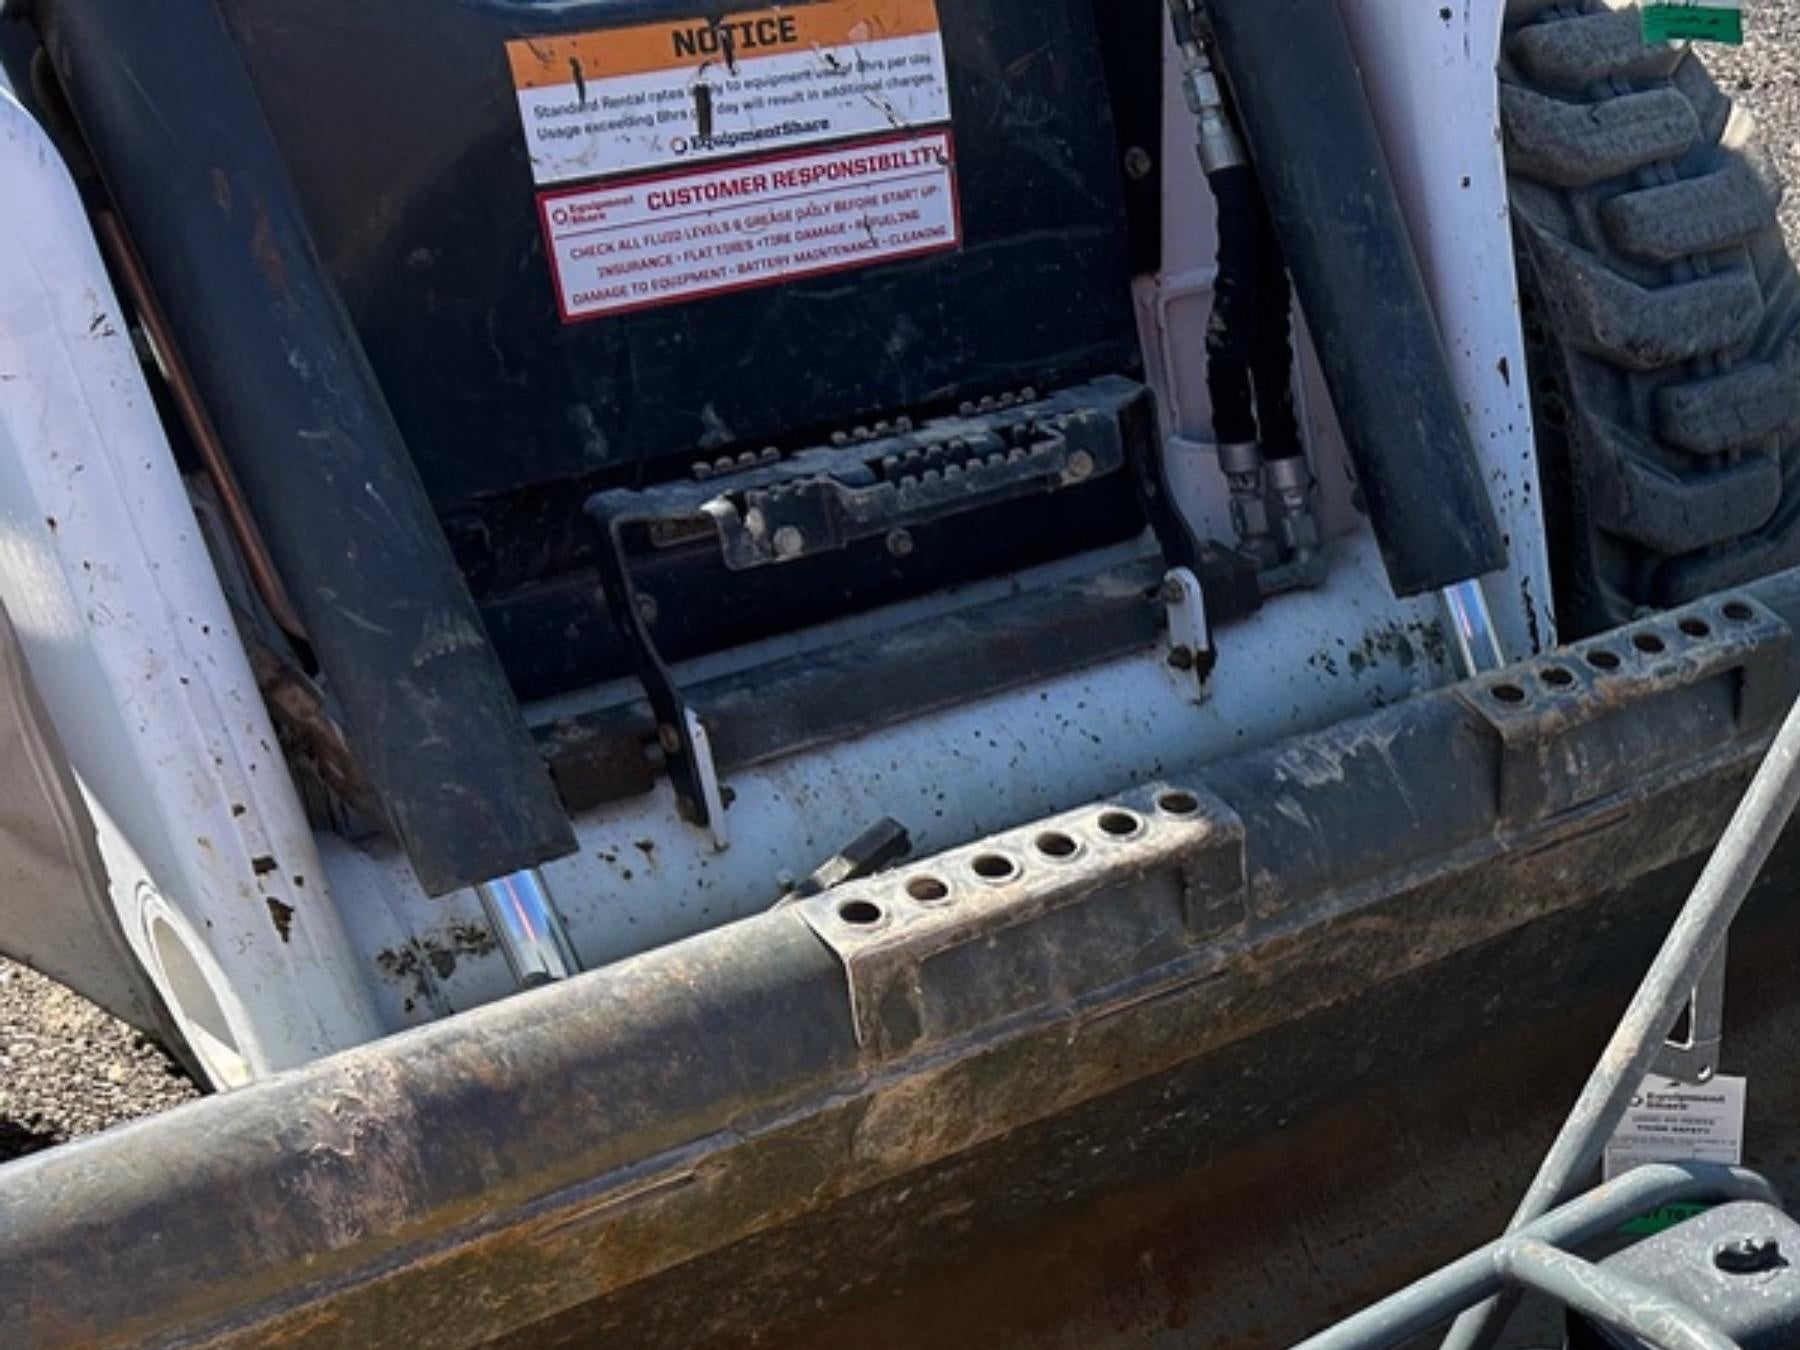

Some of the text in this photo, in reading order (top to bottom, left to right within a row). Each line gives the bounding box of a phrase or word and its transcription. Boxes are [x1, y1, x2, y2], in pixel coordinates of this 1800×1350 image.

[672, 15, 797, 58] NOTICE
[534, 99, 598, 119] Standard
[602, 92, 645, 109] Rental
[648, 88, 684, 102] rates
[726, 78, 741, 91] to
[744, 70, 811, 90] equipment
[887, 56, 906, 71] per
[536, 124, 581, 141] Usage
[585, 114, 654, 132] exceeding
[744, 96, 764, 110] will
[767, 91, 804, 106] result
[807, 87, 819, 99] in
[822, 79, 883, 98] additional
[690, 118, 830, 151] EquipmentShare
[569, 195, 634, 213] Equipment
[647, 145, 946, 211] CUSTOMER RESPONSIBILITY
[570, 243, 615, 260] CHECK
[618, 239, 641, 251] ALL
[644, 230, 682, 247] FLUID
[685, 219, 730, 237] LEVELS
[743, 209, 792, 229] GREASE
[795, 202, 831, 219] DAILY
[834, 194, 878, 212] BEFORE
[882, 187, 917, 203] START
[921, 184, 937, 198] UP
[571, 211, 606, 225] Share
[597, 253, 673, 279] INSURANCE
[683, 244, 713, 262] FLAT
[716, 239, 754, 256] TIRES
[795, 222, 845, 241] DAMAGE
[855, 209, 920, 230] REFUELING
[572, 224, 946, 305] DAMAGE TO EQUIPMENT BATTERY MAINTENANCE CLEANING
